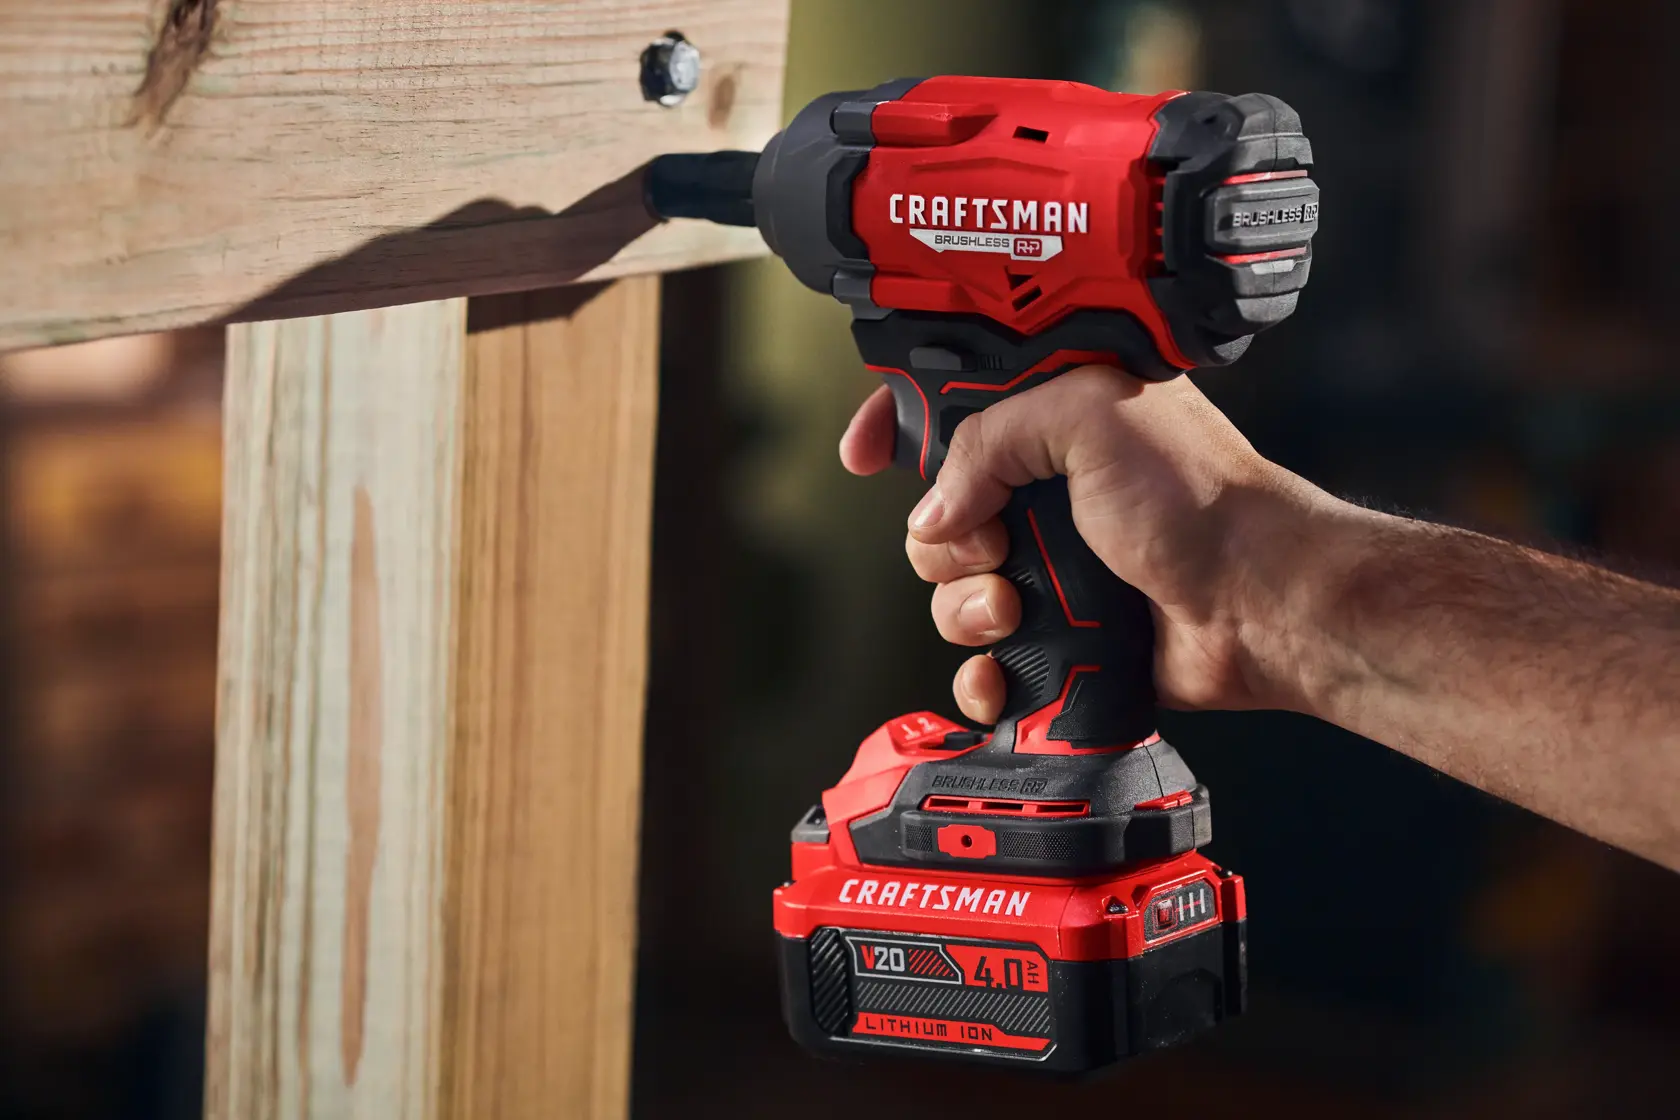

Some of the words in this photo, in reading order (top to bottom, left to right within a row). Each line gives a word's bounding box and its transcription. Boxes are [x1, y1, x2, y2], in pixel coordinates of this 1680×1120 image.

[889, 193, 1088, 234] CRAFTSMAN
[1232, 207, 1303, 227] BRUSHLESS
[934, 234, 1010, 248] BRUSHLESS
[931, 774, 1020, 793] BRUSHLESS
[838, 879, 1032, 917] CRAFTSMAN
[860, 944, 906, 972] V20
[973, 955, 1024, 990] 4.0
[1026, 960, 1040, 985] AH
[865, 1016, 948, 1038] LITHIUM
[960, 1025, 993, 1041] ION
